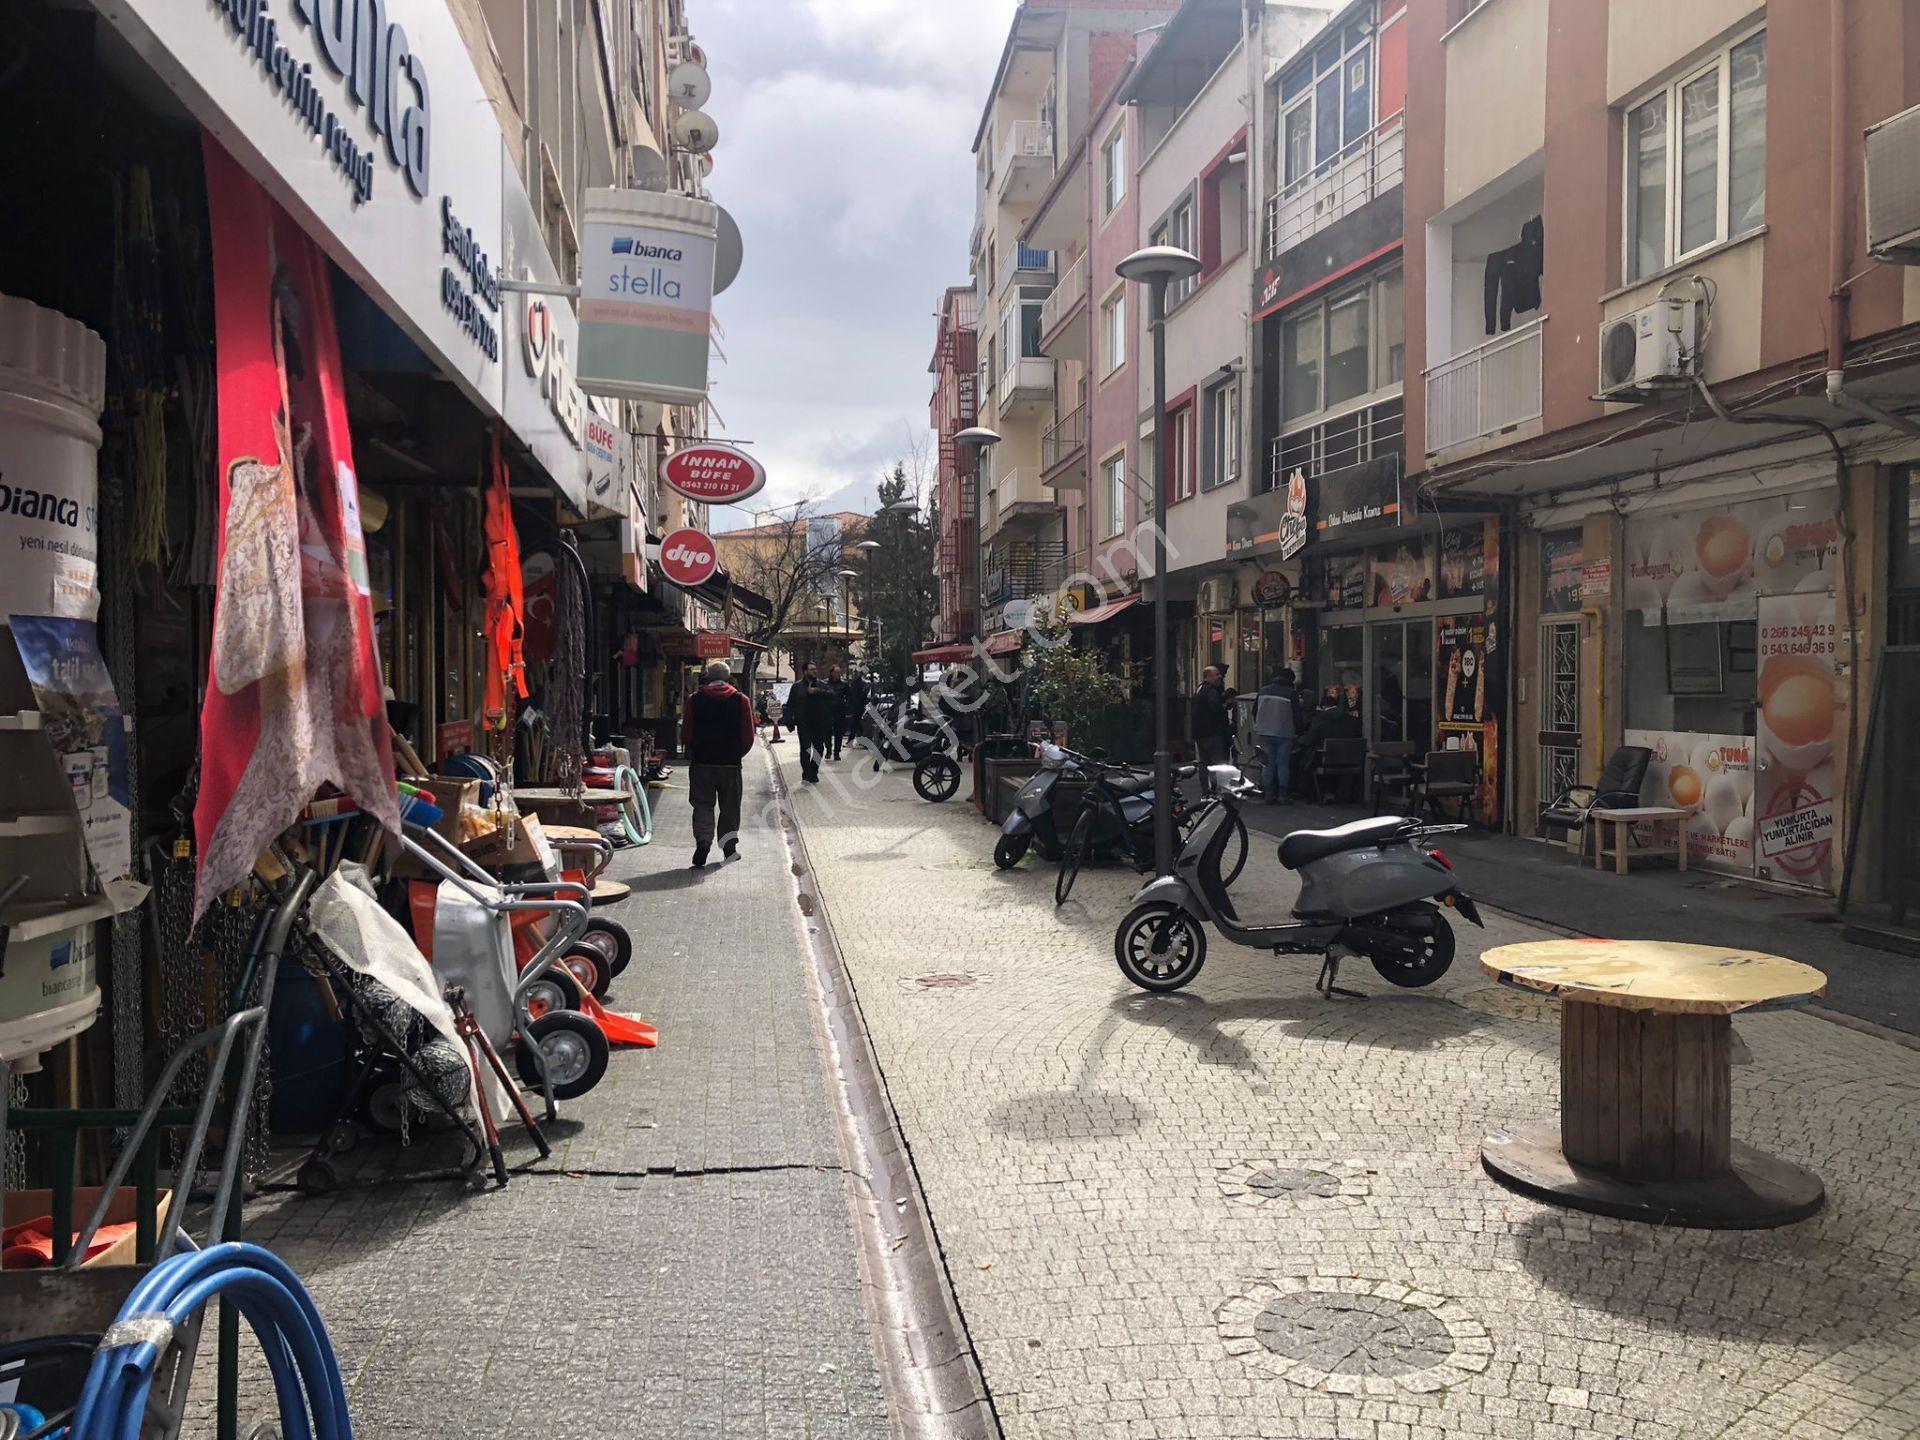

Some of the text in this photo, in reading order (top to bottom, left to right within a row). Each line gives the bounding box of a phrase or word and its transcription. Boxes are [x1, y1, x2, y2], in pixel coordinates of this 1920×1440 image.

[325, 112, 374, 204] rengi
[634, 240, 683, 262] bianca
[609, 265, 681, 299] stella
[588, 421, 614, 450] BÜFE
[681, 453, 742, 470] İNNAN
[690, 469, 733, 481] BÜFE
[19, 534, 44, 550] yeni
[47, 540, 69, 554] nesil
[665, 543, 711, 568] dyo
[1761, 628, 1767, 639] 0
[1770, 626, 1789, 638] 266
[1790, 626, 1810, 637] 245
[1812, 625, 1825, 636] 42
[1761, 645, 1767, 656] 0
[1770, 644, 1789, 656] 543
[1790, 643, 1810, 656] 646
[1812, 643, 1825, 654] 36
[1719, 746, 1749, 764] TUNA
[1774, 809, 1818, 828] YUMURTA
[1699, 833, 1750, 849] MARKETLERE
[1784, 832, 1815, 847] ALINIR
